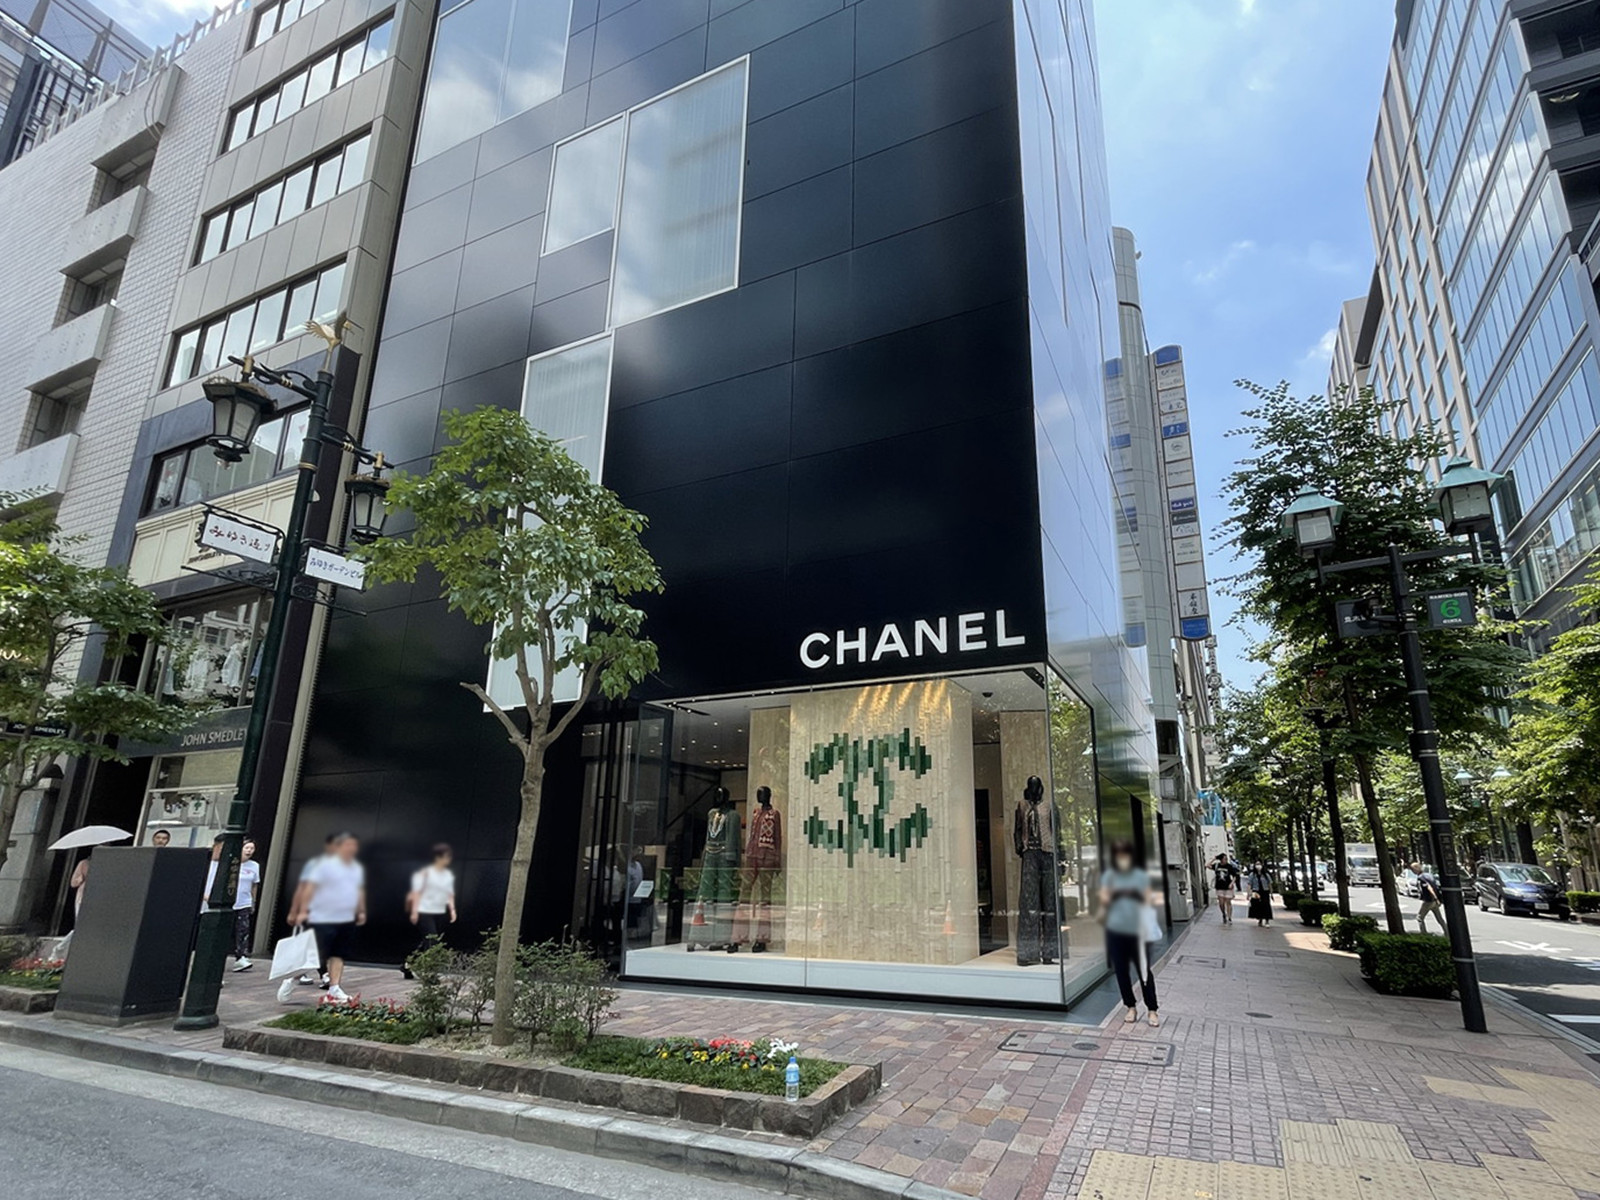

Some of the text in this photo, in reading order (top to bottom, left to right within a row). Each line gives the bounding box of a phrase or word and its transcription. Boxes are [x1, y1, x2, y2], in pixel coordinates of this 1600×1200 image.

[208, 524, 272, 552] みゆき通り
[1440, 599, 1461, 618] 6
[799, 609, 1026, 669] CHANEL
[181, 732, 207, 747] JOHN
